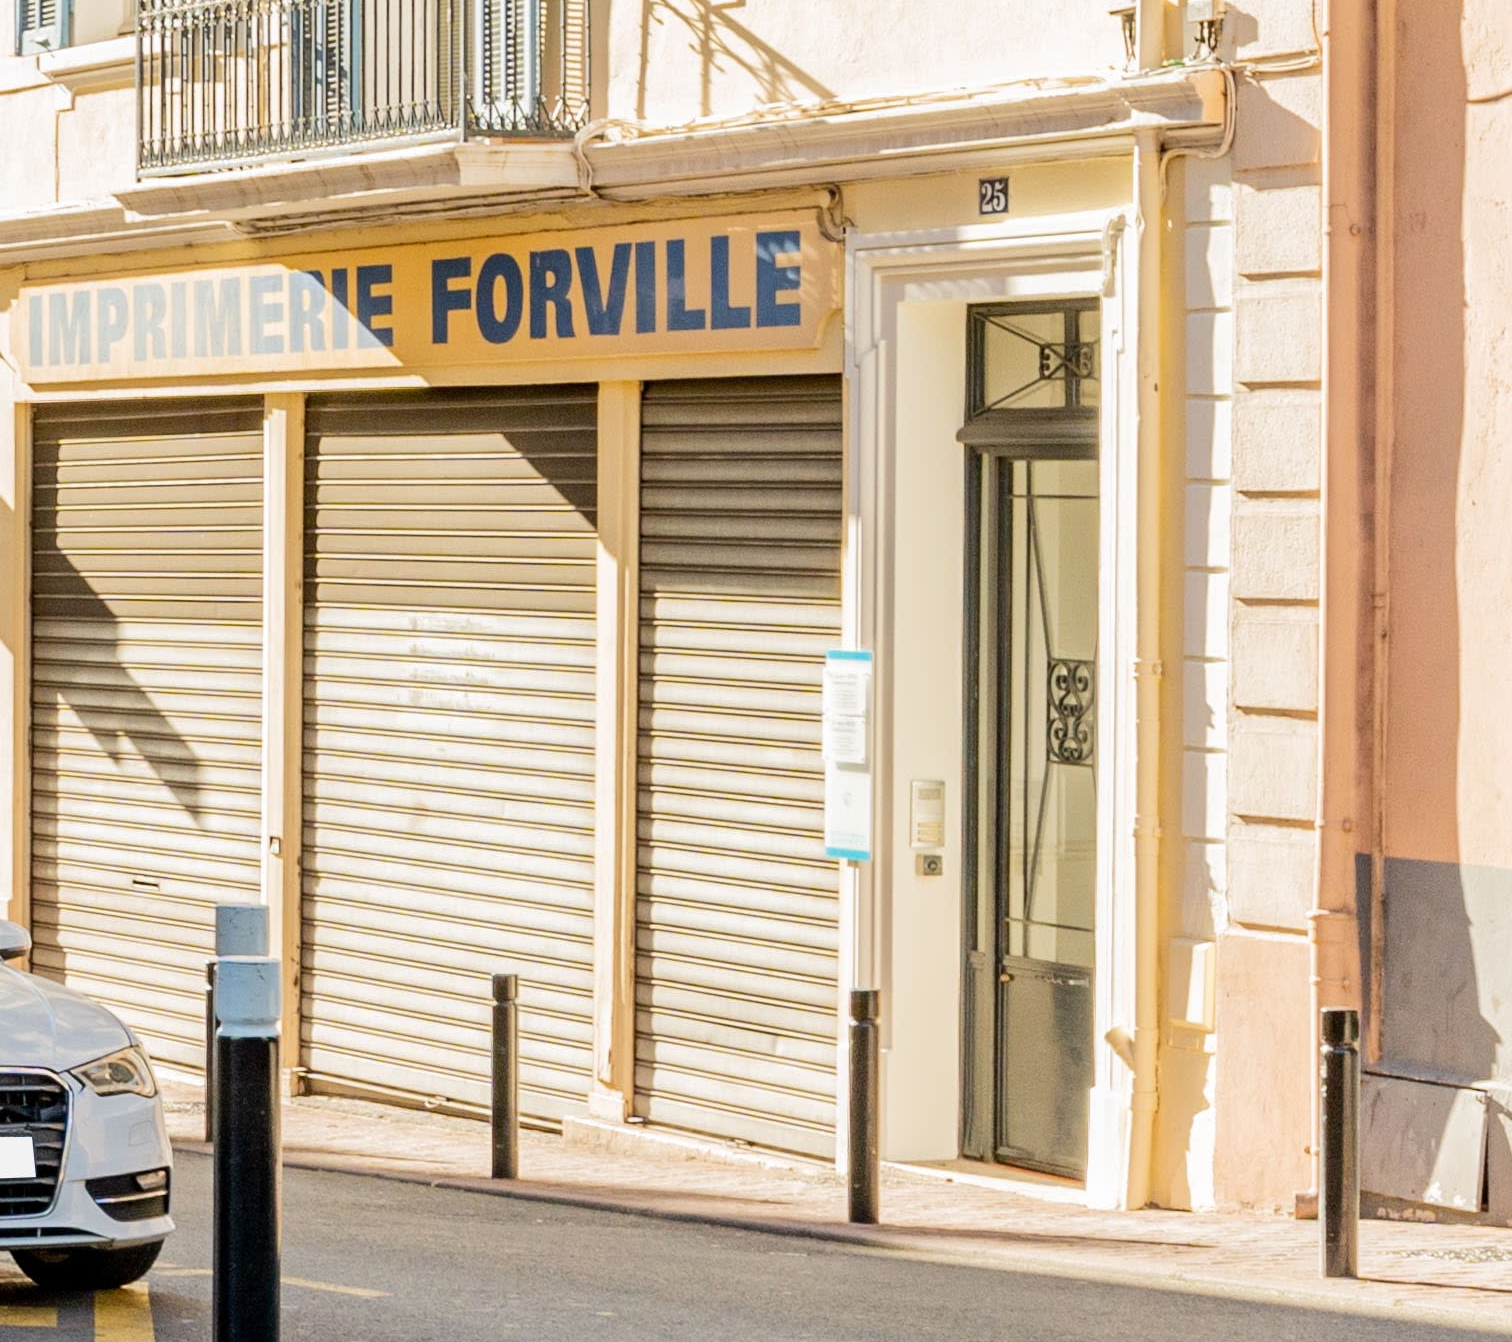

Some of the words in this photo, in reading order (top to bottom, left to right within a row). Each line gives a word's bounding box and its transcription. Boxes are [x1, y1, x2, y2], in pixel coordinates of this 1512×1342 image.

[981, 181, 1006, 212] 25
[28, 263, 394, 368] IMPRIMERIE
[431, 229, 802, 345] FORVILLE
